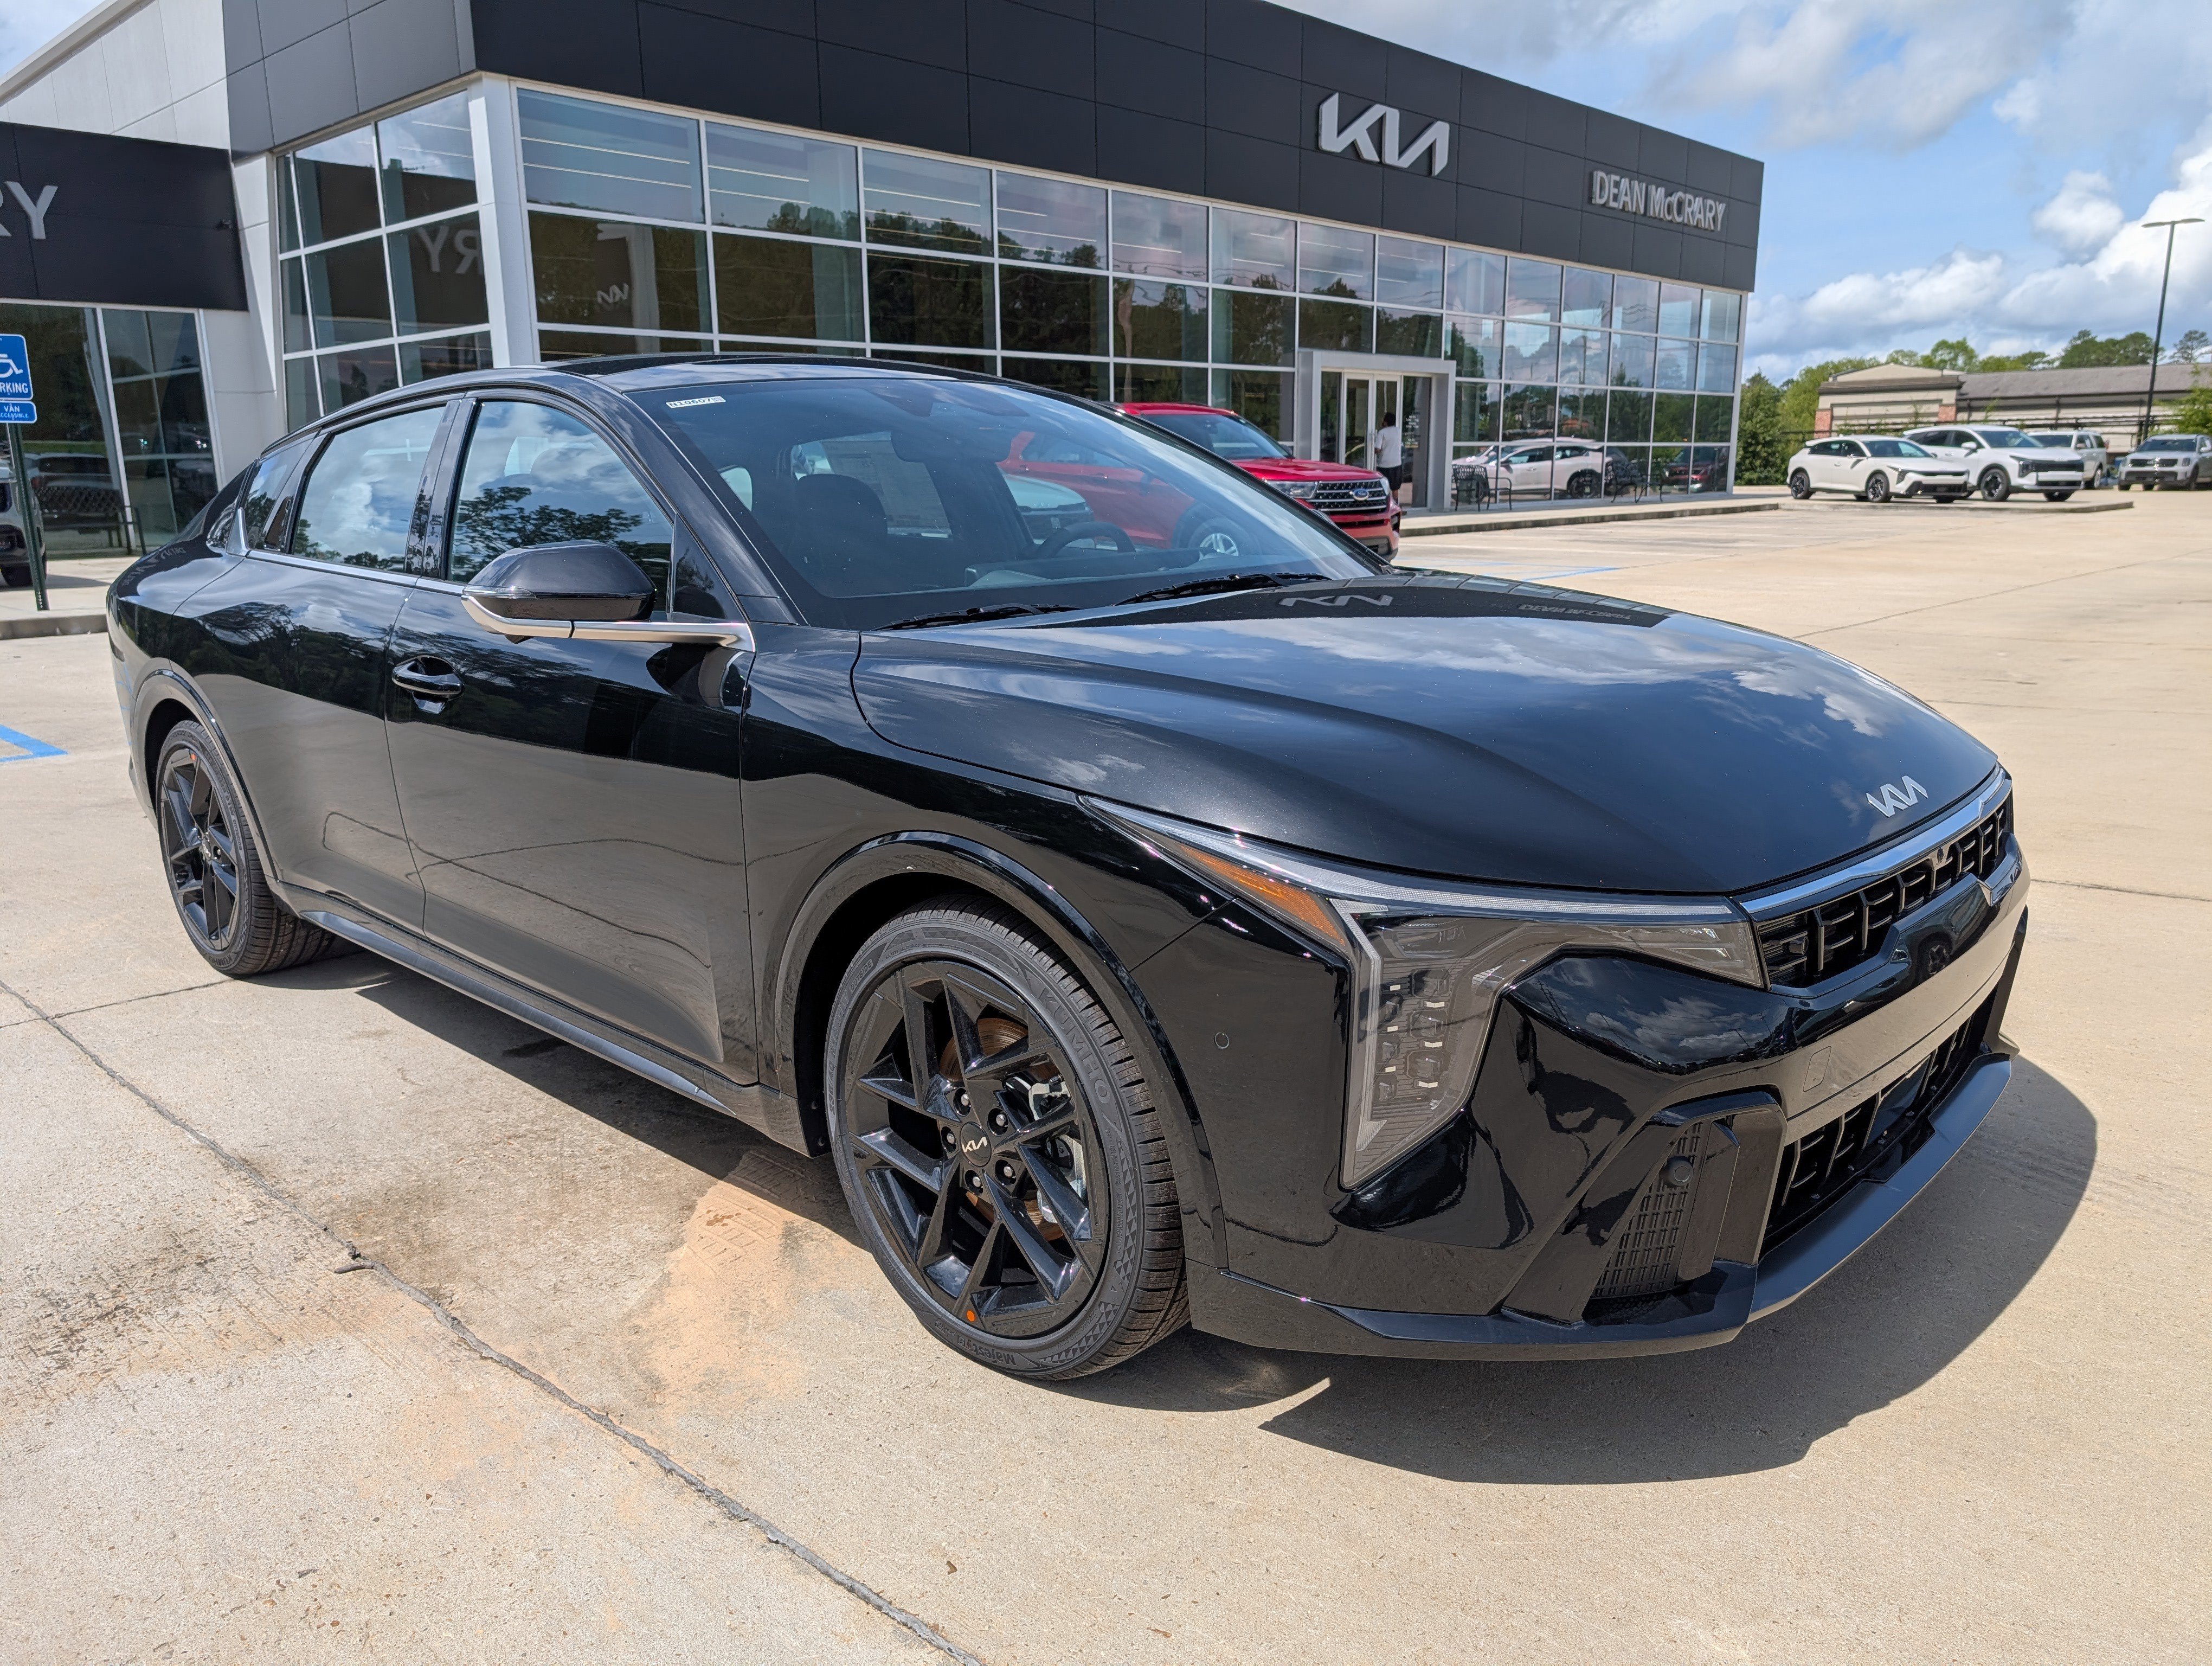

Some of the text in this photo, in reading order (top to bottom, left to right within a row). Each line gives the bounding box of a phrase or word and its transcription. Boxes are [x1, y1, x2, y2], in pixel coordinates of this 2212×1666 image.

[1319, 92, 1450, 176] KIA
[1592, 171, 1726, 232] DEAN McCRARY
[1866, 775, 1928, 818] KIA
[850, 959, 873, 994] OUTSIDE
[1037, 987, 1110, 1104] KUMHO
[961, 1136, 988, 1153] KIA
